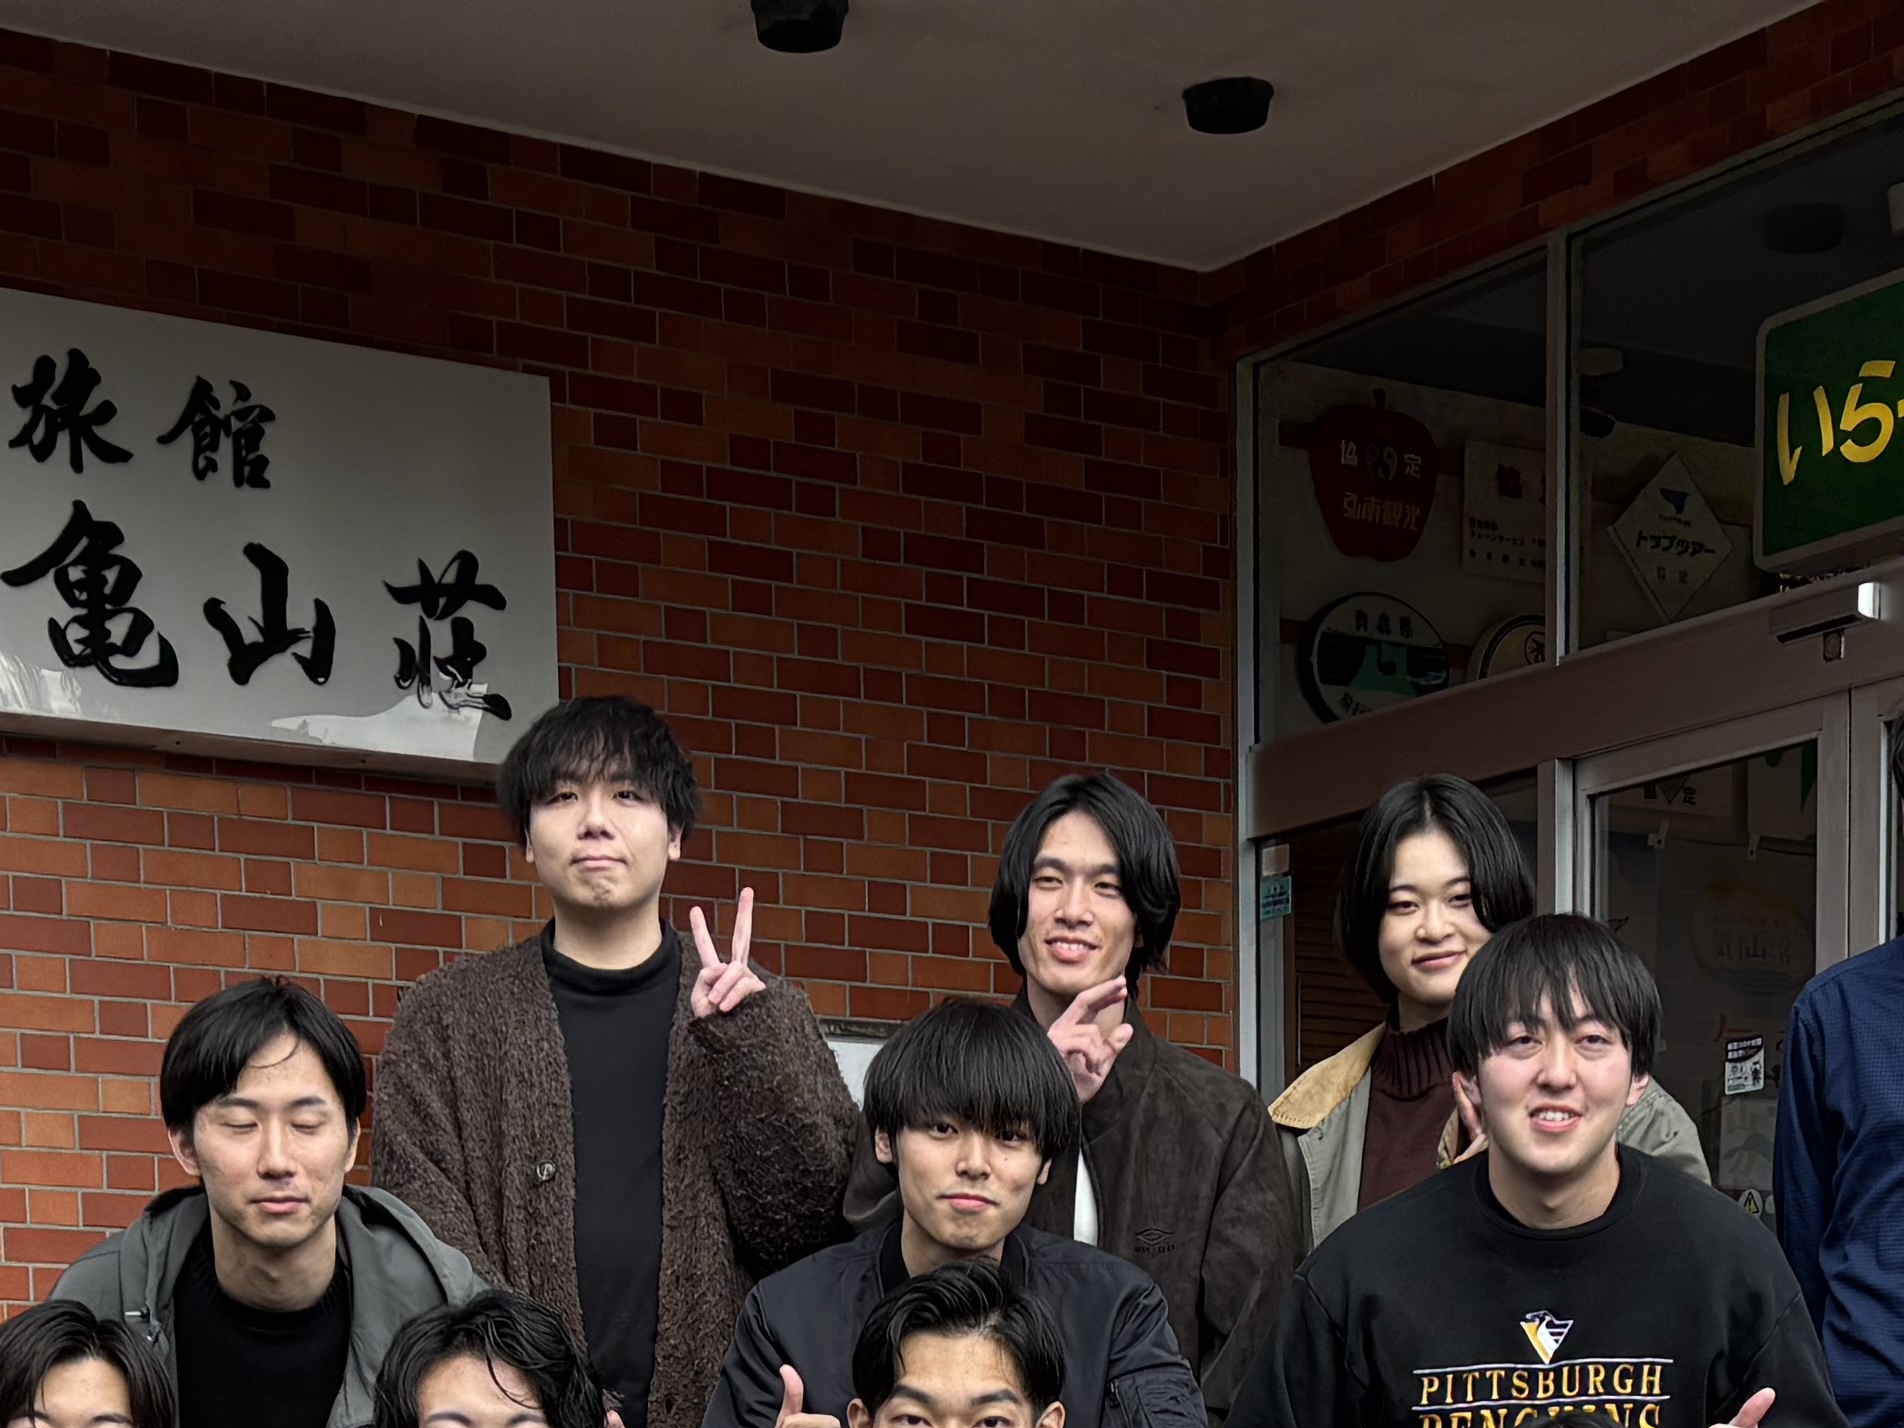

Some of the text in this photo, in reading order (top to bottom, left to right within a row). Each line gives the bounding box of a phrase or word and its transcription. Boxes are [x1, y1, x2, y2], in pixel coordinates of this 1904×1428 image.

[8, 347, 277, 489] 旅館
[0, 499, 513, 721] 亀山荘
[1420, 1364, 1663, 1404] PITTSBURGH
